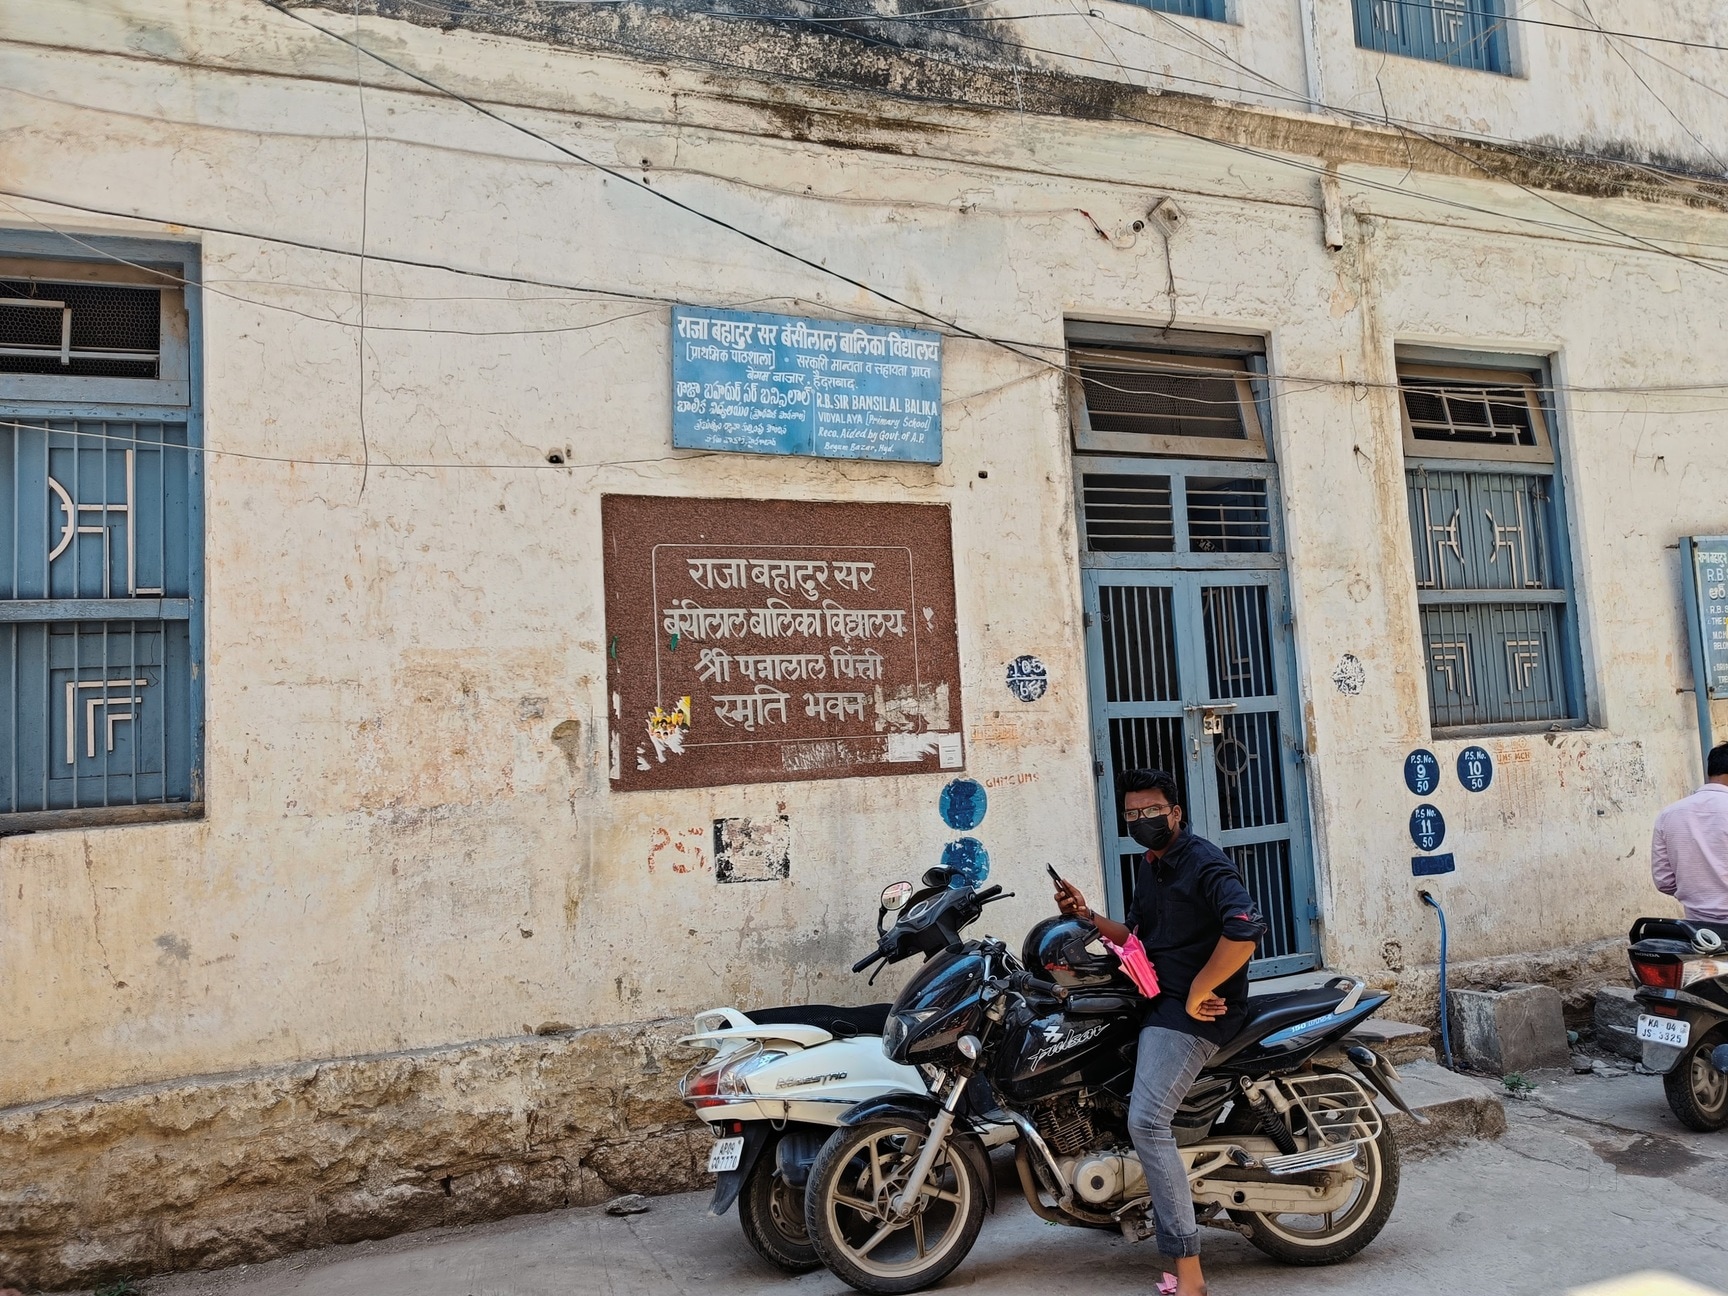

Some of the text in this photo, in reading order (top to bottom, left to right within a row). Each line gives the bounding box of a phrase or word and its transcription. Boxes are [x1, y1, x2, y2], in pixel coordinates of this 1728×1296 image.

[677, 316, 940, 361] राजा बहादुर सर बंसीलाल बालिका विद्यालय
[796, 354, 829, 371] सरकारी
[865, 362, 874, 375] व
[852, 395, 902, 412] BANSILAL
[905, 398, 938, 416] BALIKA
[817, 411, 863, 424] VIDYALAYA
[840, 428, 866, 439] Aided
[867, 430, 878, 443] by
[901, 431, 910, 441] of
[910, 433, 925, 443] A.P.
[824, 442, 848, 453] Begum
[686, 558, 876, 600] राजा बहादुर सर
[663, 597, 906, 640] बंसीलाल बालिका विद्यालय
[694, 647, 733, 683] श्री
[734, 654, 826, 681] पन्नालाल
[711, 684, 866, 731] स्मृति भवन
[1416, 764, 1426, 779] 9
[1468, 760, 1482, 776] 10
[1416, 780, 1429, 793] 50
[1471, 778, 1483, 790] 50
[1420, 819, 1432, 834] 11
[1422, 836, 1434, 848] 50
